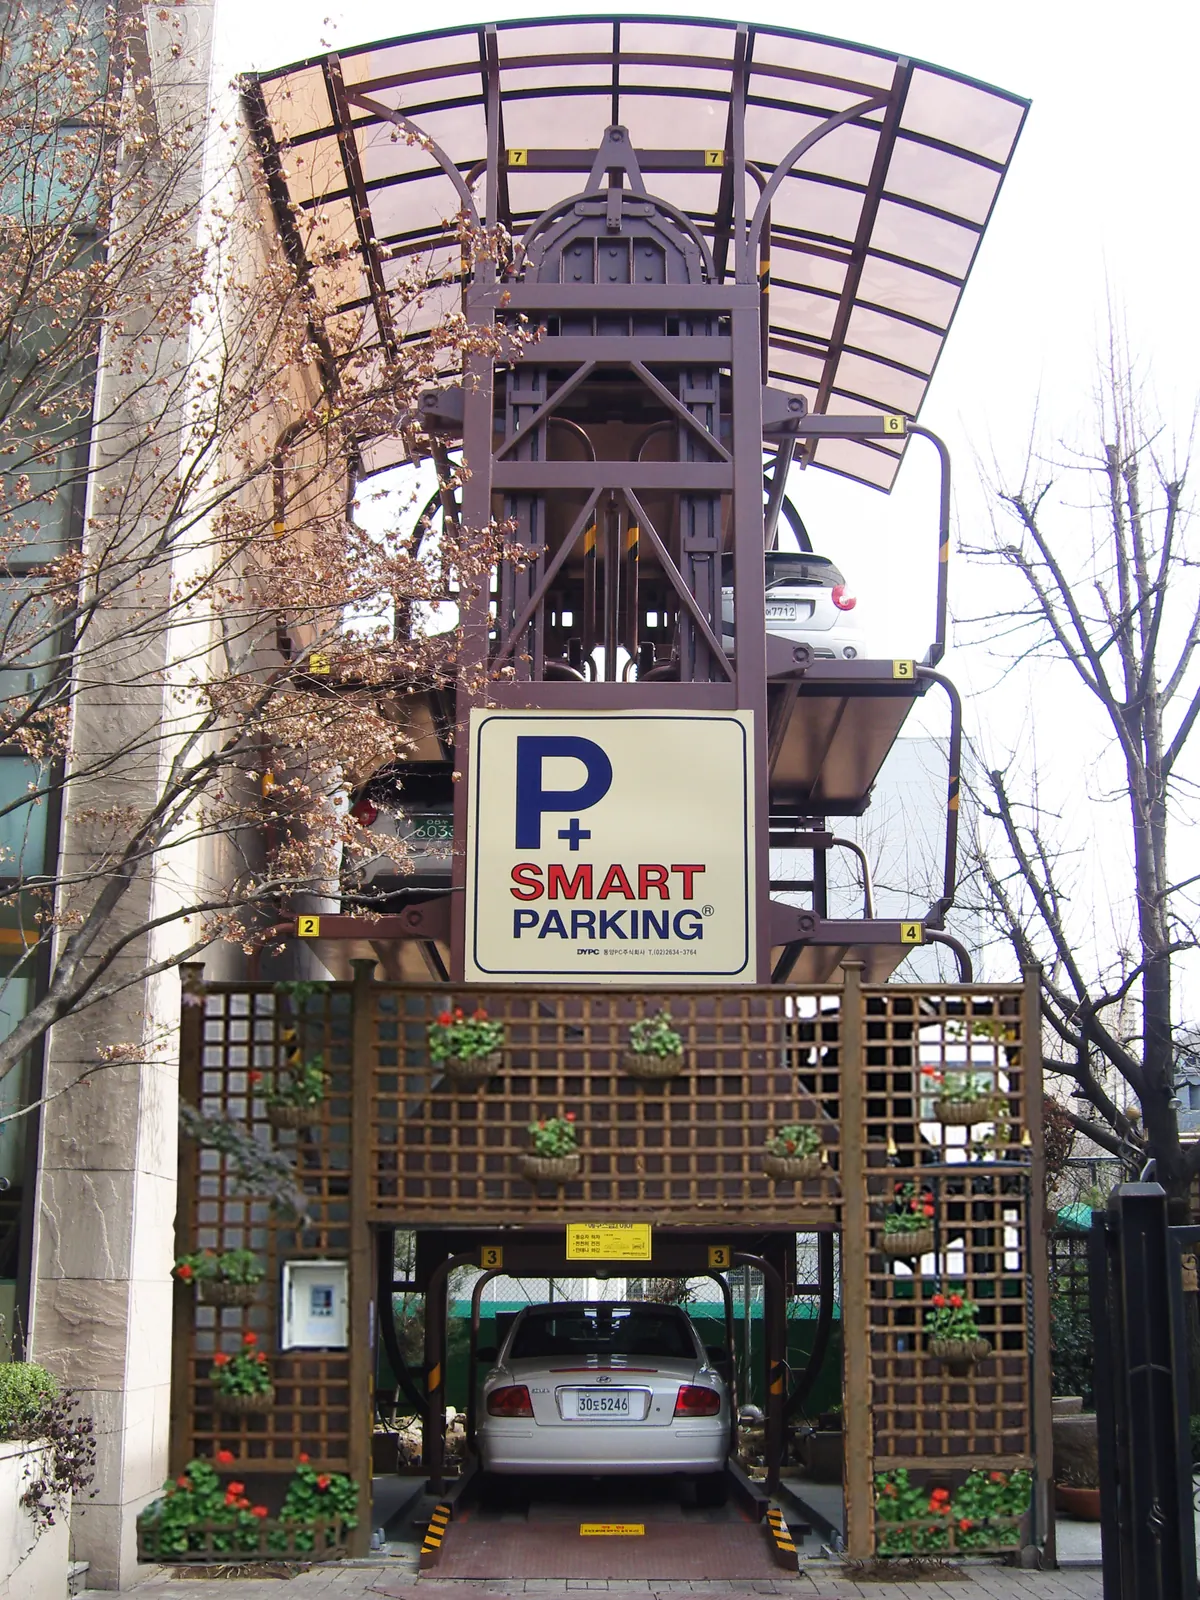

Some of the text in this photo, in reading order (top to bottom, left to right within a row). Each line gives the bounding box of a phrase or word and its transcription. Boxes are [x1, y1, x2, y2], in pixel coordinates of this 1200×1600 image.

[514, 152, 522, 163] 7
[710, 153, 719, 163] 7
[889, 418, 899, 430] 6
[899, 663, 908, 675] 5
[509, 862, 706, 902] SMART
[304, 919, 314, 933] 2
[513, 908, 704, 941] PARKING
[907, 926, 917, 939] 4
[577, 948, 600, 956] DYPC
[487, 1250, 498, 1264] 3
[714, 1250, 724, 1264] 3
